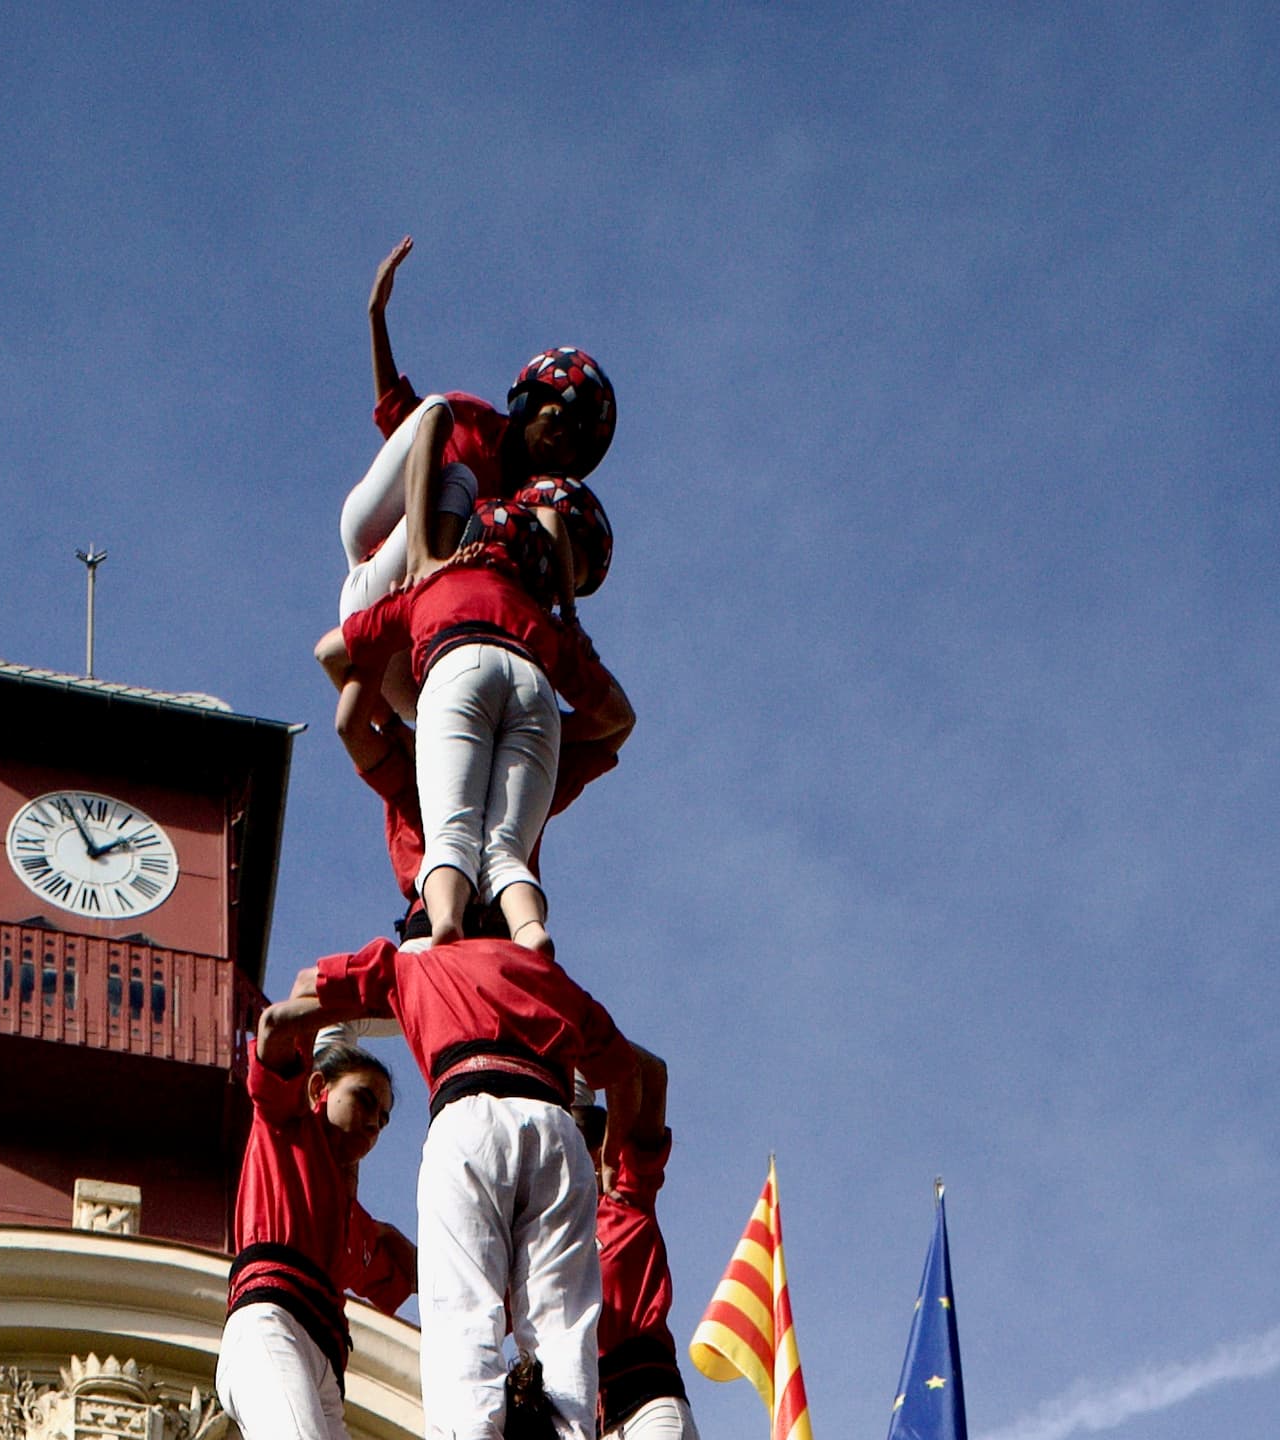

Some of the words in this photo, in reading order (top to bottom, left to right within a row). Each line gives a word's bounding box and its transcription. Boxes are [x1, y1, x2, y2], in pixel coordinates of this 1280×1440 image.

[81, 797, 108, 823] XII
[25, 811, 55, 834] X
[117, 813, 133, 830] I
[16, 833, 45, 851] IX
[133, 834, 161, 849] II
[139, 857, 169, 876] III
[42, 875, 72, 902] VII
[113, 888, 135, 911] V
